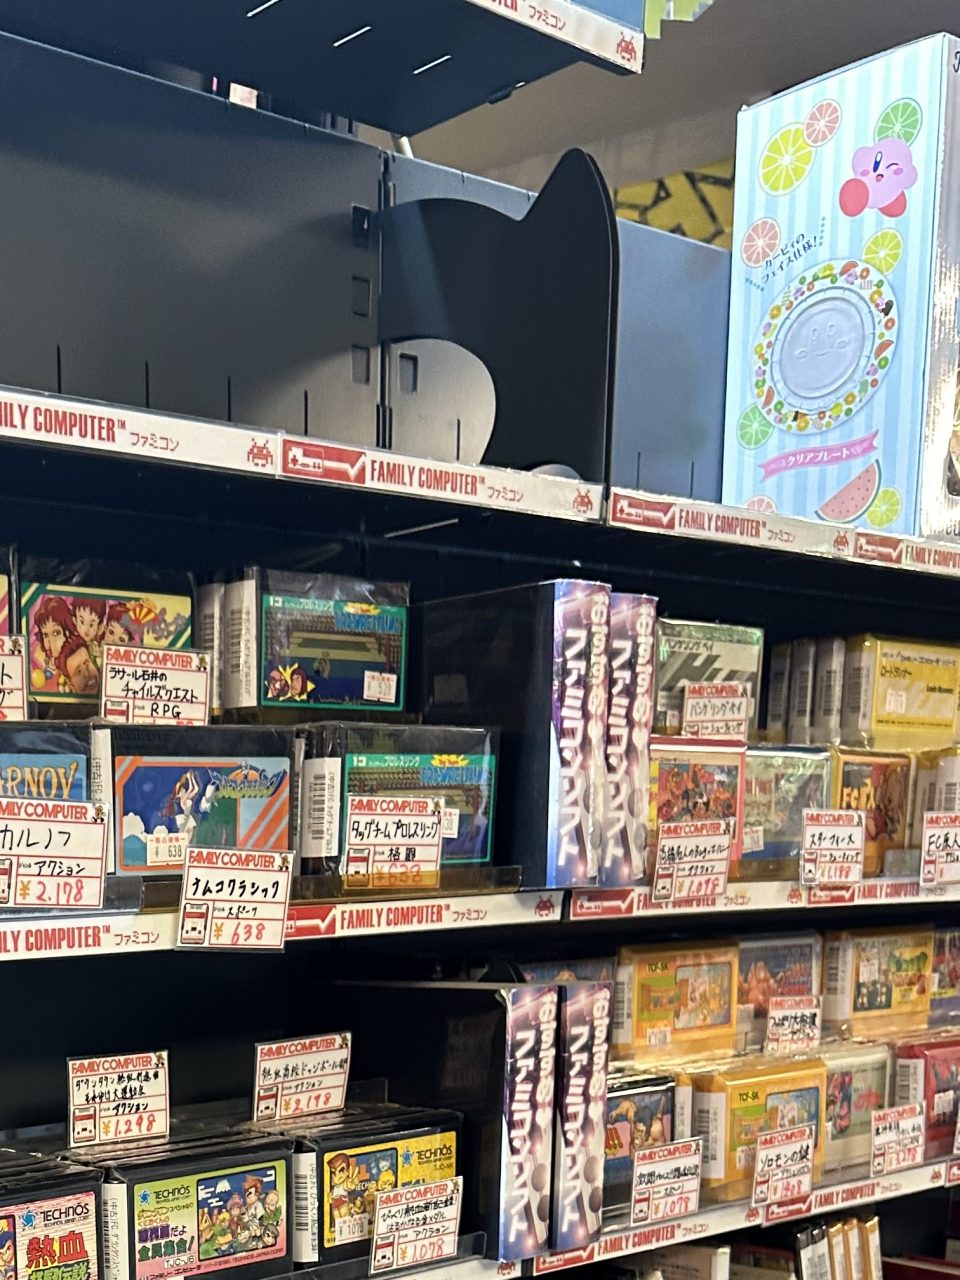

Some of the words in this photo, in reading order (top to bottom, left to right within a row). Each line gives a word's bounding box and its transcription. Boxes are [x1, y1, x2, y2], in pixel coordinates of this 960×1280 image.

[130, 432, 180, 452] ファミコン
[370, 459, 416, 487] FAMILY
[487, 486, 524, 501] ファミコン
[106, 648, 139, 664] FAMILY
[139, 651, 192, 668] COMPUTER
[109, 667, 167, 682] ラサール石井の
[150, 703, 182, 719] RPG
[24, 804, 87, 820] COMPUTER
[380, 799, 428, 814] COMPUTER
[0, 824, 72, 849] カルノフ
[34, 861, 85, 876] アクション
[188, 850, 221, 865] FAMILY
[222, 852, 275, 868] COMPUTER
[341, 907, 382, 927] FAMILY
[452, 909, 487, 921] ファミコン
[114, 932, 159, 945] ファミコン
[231, 922, 264, 944] 638
[260, 1042, 290, 1058] FAMILY
[290, 1037, 336, 1053] COMPUTER
[72, 1060, 101, 1074] FAMILY
[102, 1056, 152, 1071] COMPUTER
[379, 1191, 405, 1206] FAMILY
[406, 1185, 448, 1200] COMPUTER
[412, 1225, 449, 1238] アクション
[26, 1231, 88, 1268] 熱血
